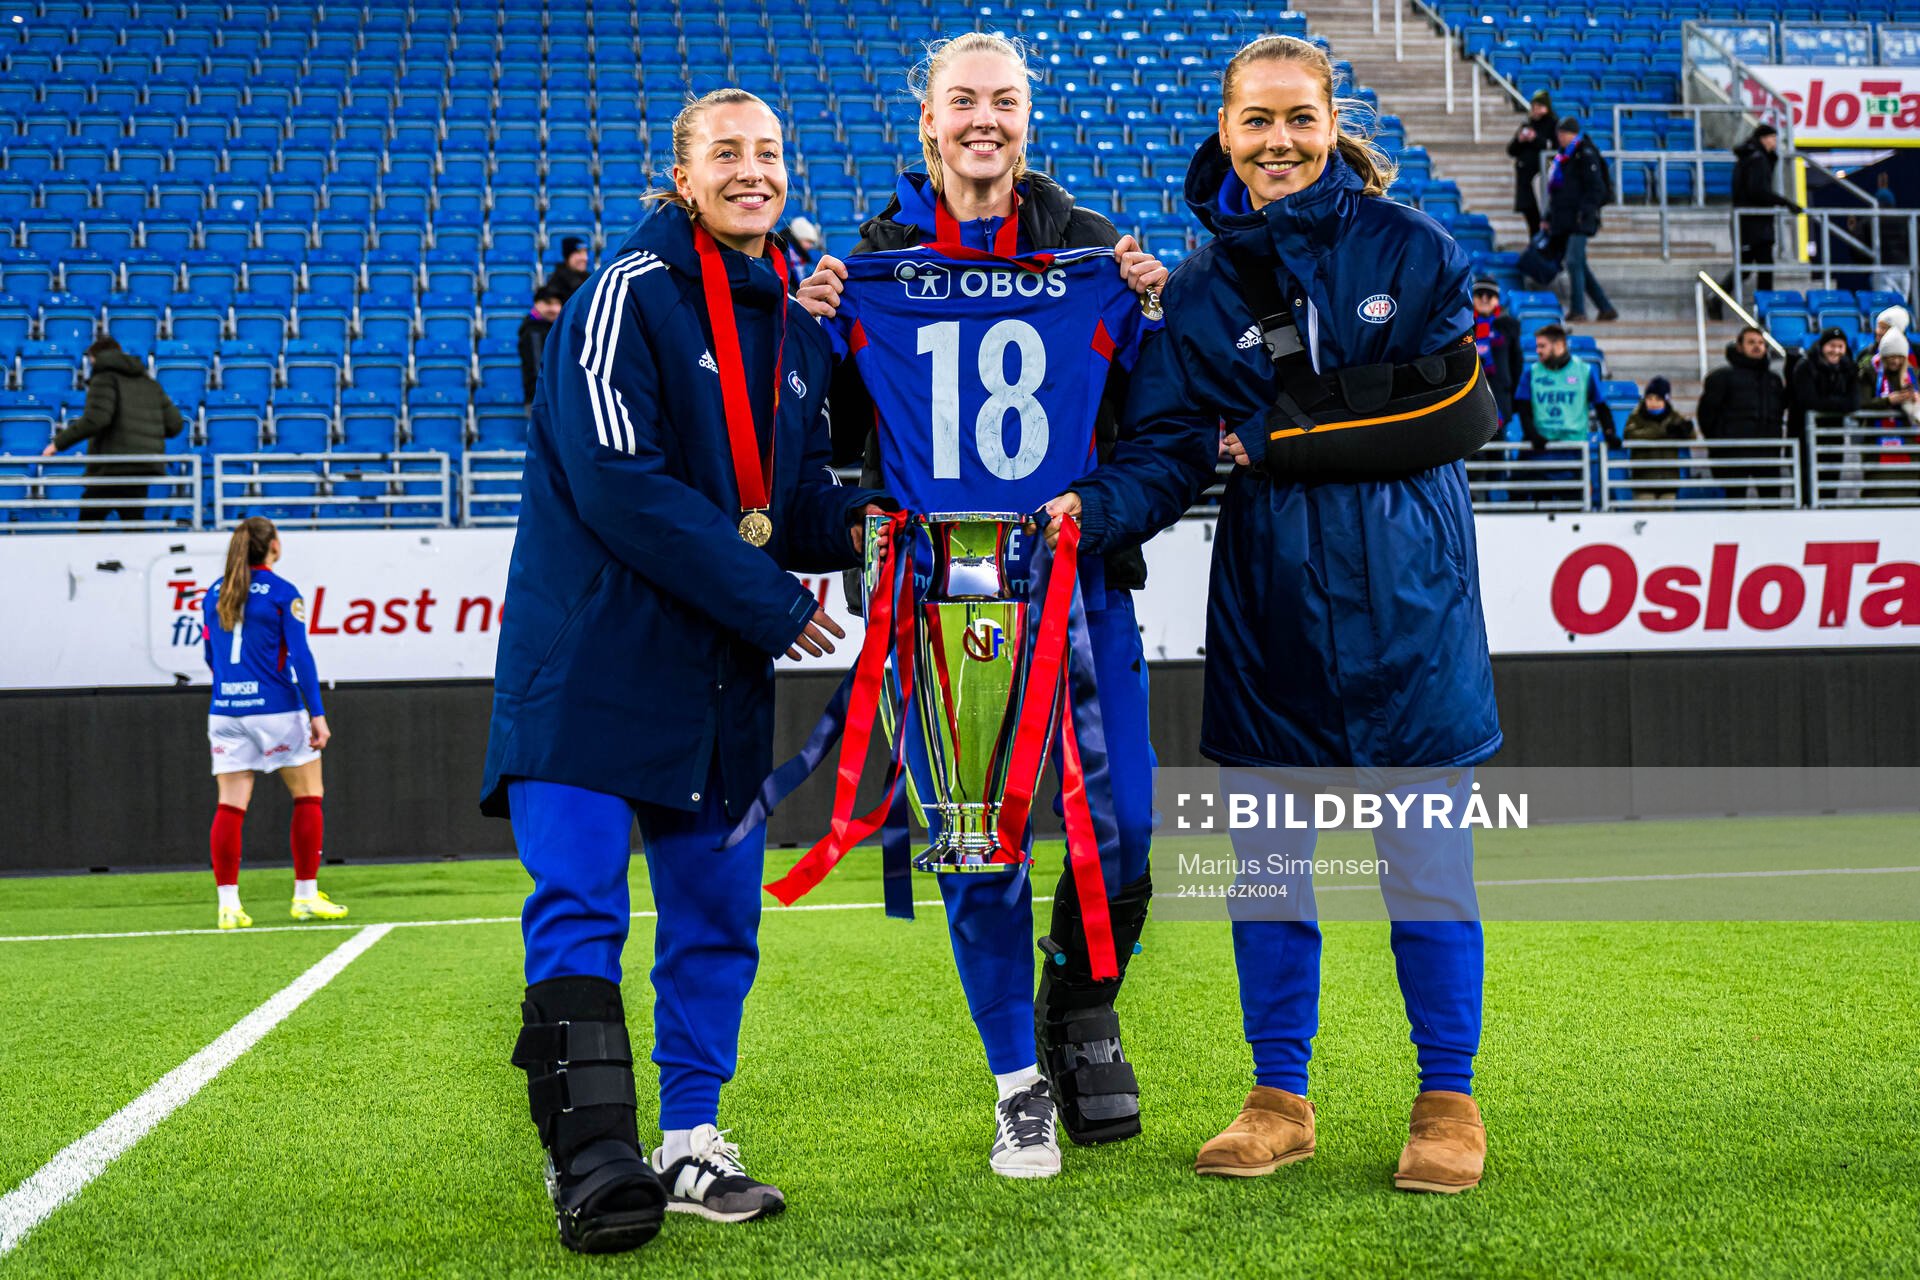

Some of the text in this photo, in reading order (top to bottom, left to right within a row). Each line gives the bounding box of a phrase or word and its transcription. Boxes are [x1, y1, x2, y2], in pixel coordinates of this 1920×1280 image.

[960, 268, 1067, 298] OBOS
[917, 319, 1049, 481] 18
[309, 586, 437, 636] Last
[1550, 541, 1920, 637] OsloTa
